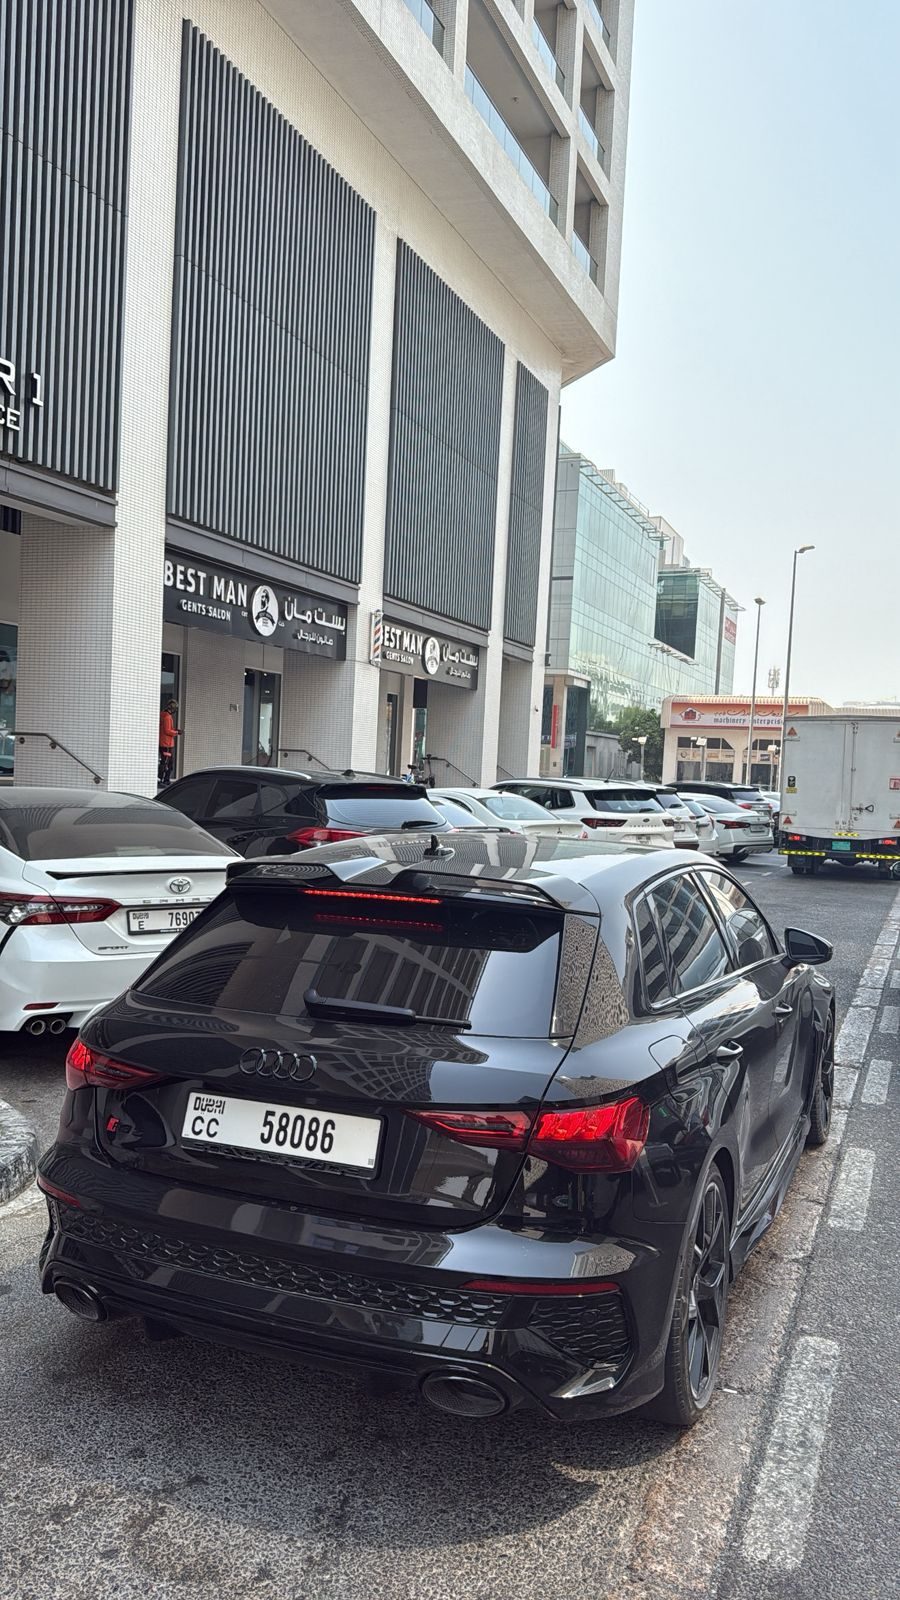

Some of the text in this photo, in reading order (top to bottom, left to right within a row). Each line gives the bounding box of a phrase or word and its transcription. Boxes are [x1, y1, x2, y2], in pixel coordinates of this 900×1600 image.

[32, 372, 44, 407] 1
[164, 560, 248, 608] BEST MAN
[180, 598, 231, 622] GENTS SALON
[284, 595, 346, 635] بست مان
[382, 625, 423, 656] EST MAN
[385, 650, 400, 662] GENTS
[749, 718, 783, 726] nterpris
[138, 911, 201, 930] E 7690
[191, 1110, 336, 1154] CC 58086
